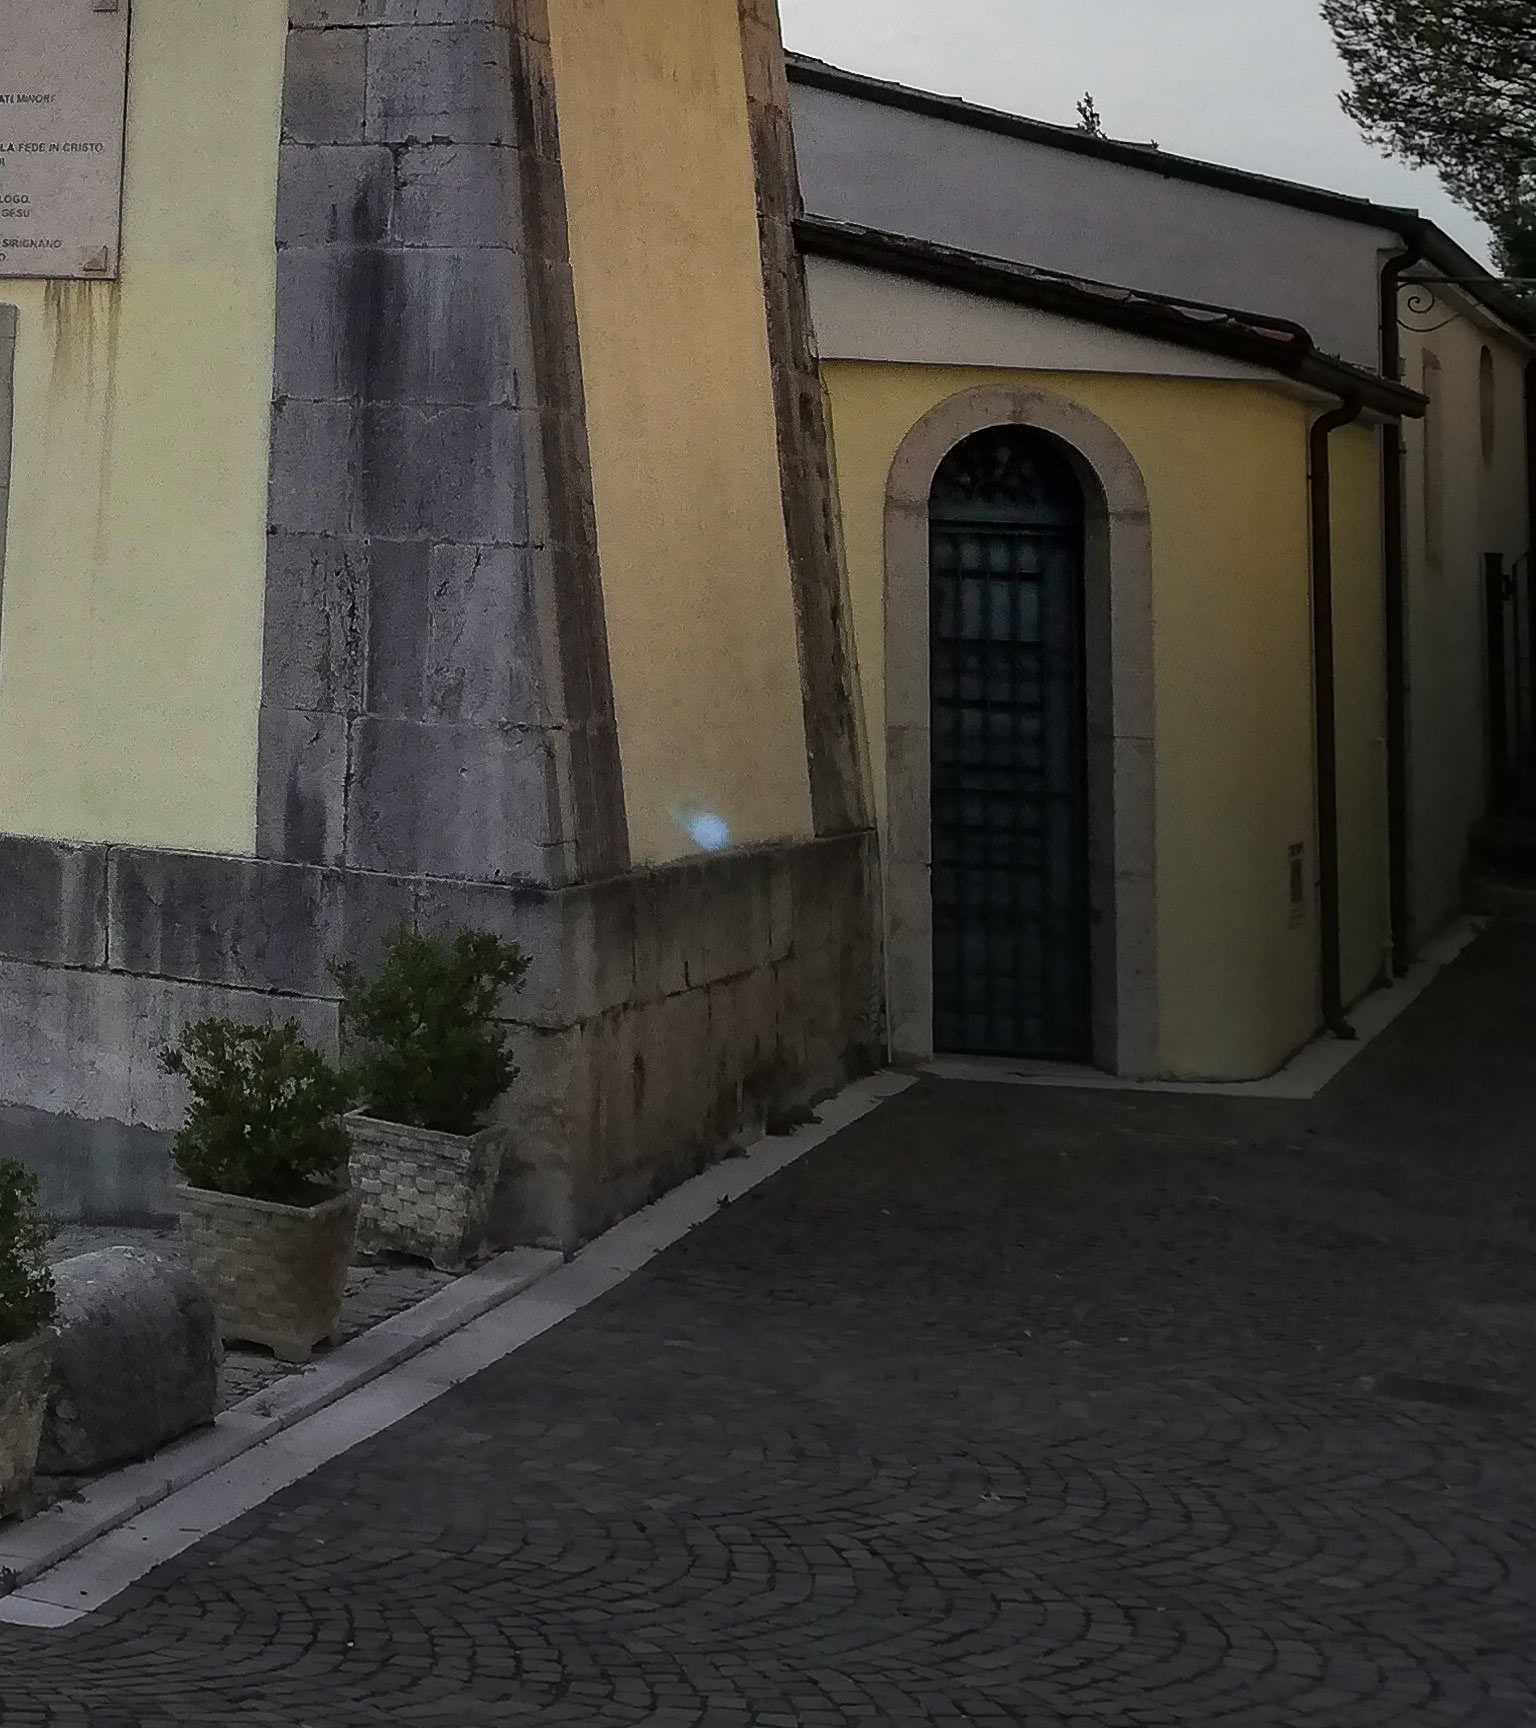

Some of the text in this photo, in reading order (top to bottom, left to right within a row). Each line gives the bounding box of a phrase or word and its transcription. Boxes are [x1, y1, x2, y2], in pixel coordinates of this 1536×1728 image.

[0, 143, 15, 152] LA
[19, 143, 45, 152] FEDE
[49, 143, 59, 152] IN
